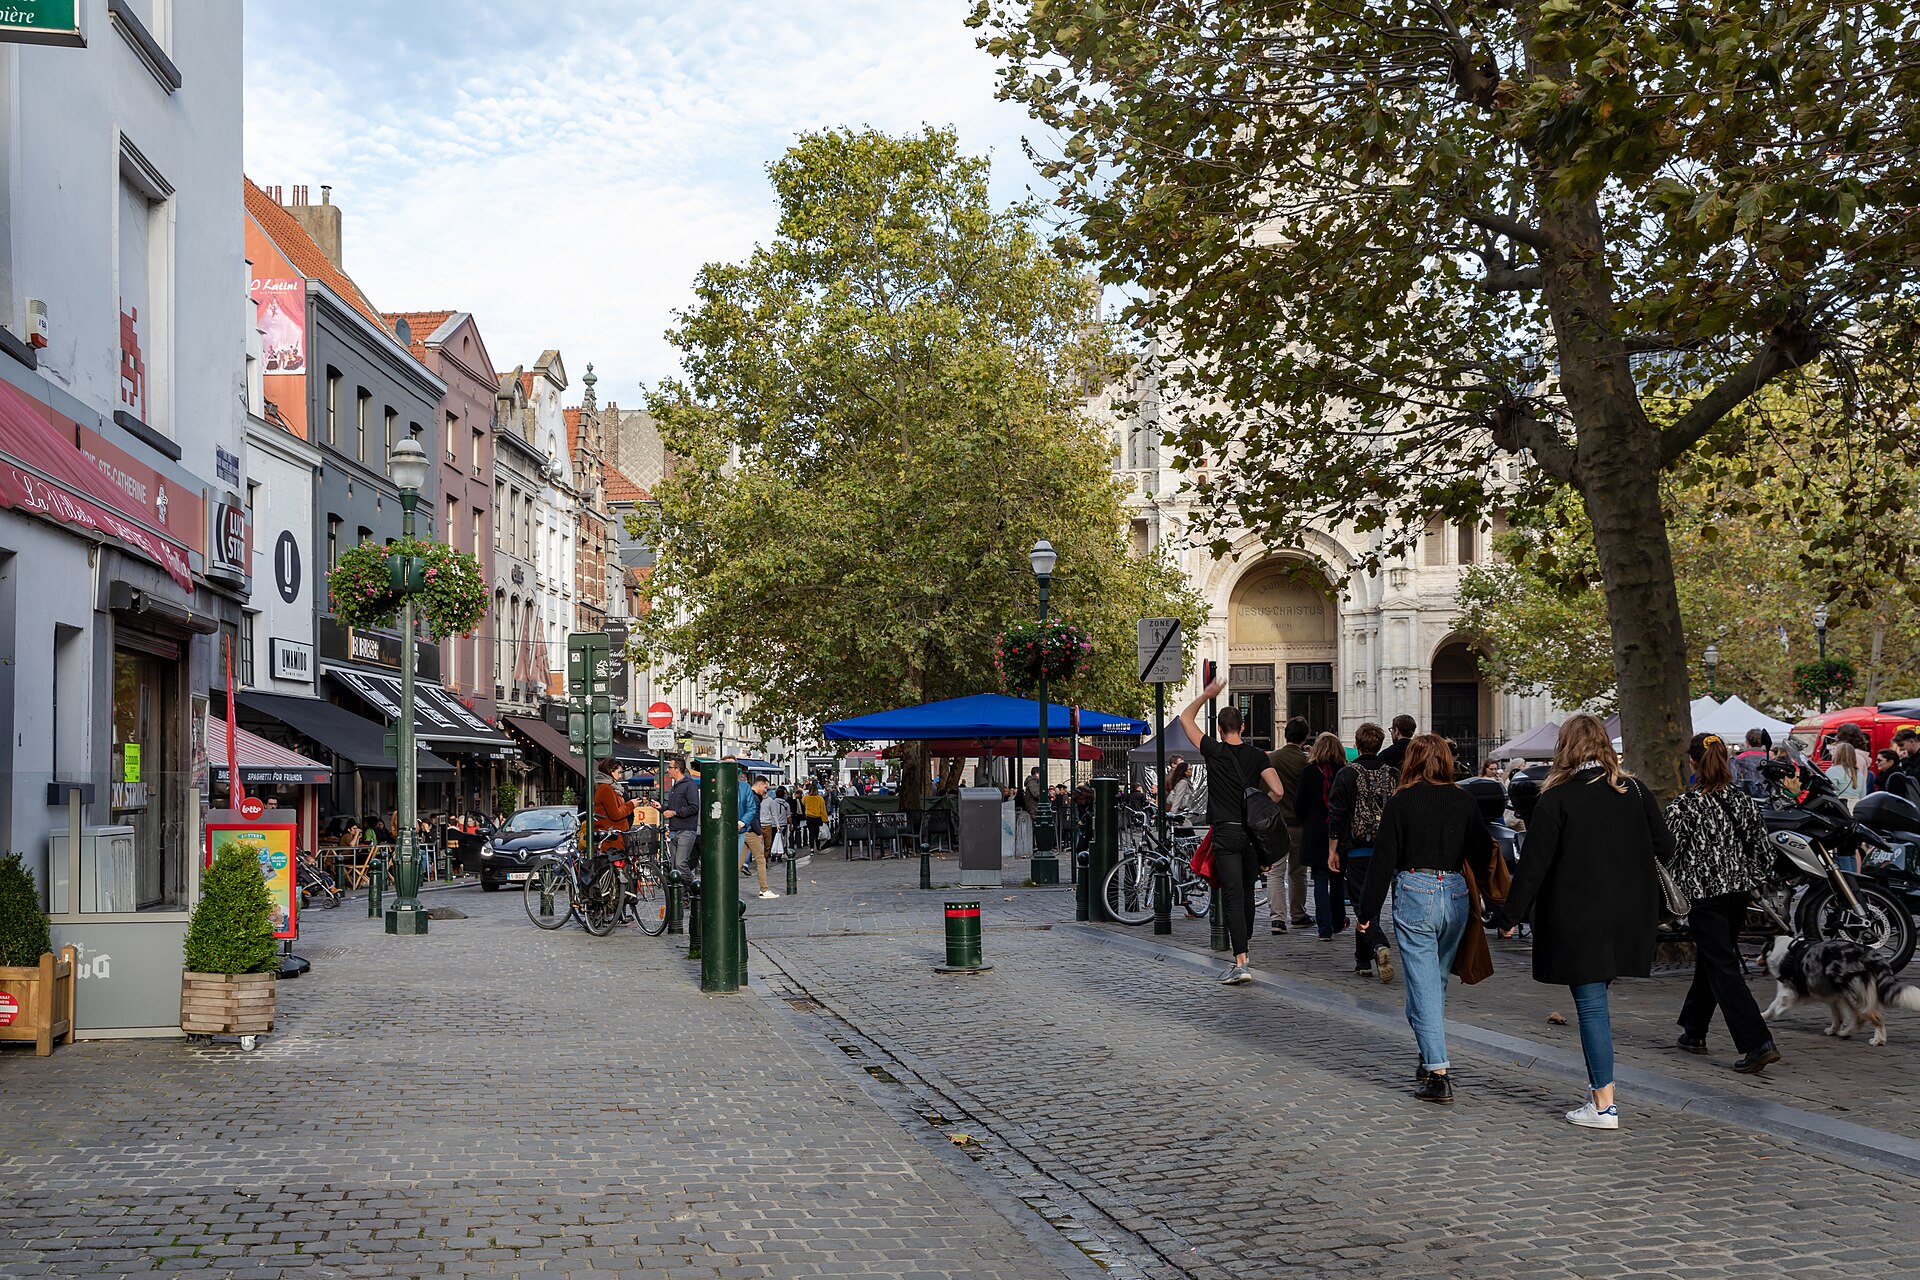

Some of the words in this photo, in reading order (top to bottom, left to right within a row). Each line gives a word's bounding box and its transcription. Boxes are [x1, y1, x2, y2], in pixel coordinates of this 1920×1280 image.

[263, 279, 298, 290] Latini
[247, 772, 272, 780] SPAGHETTI
[272, 772, 282, 780] FOR
[283, 773, 302, 781] FRIENDS
[124, 782, 148, 806] STRIKE
[1788, 841, 1807, 849] GS
